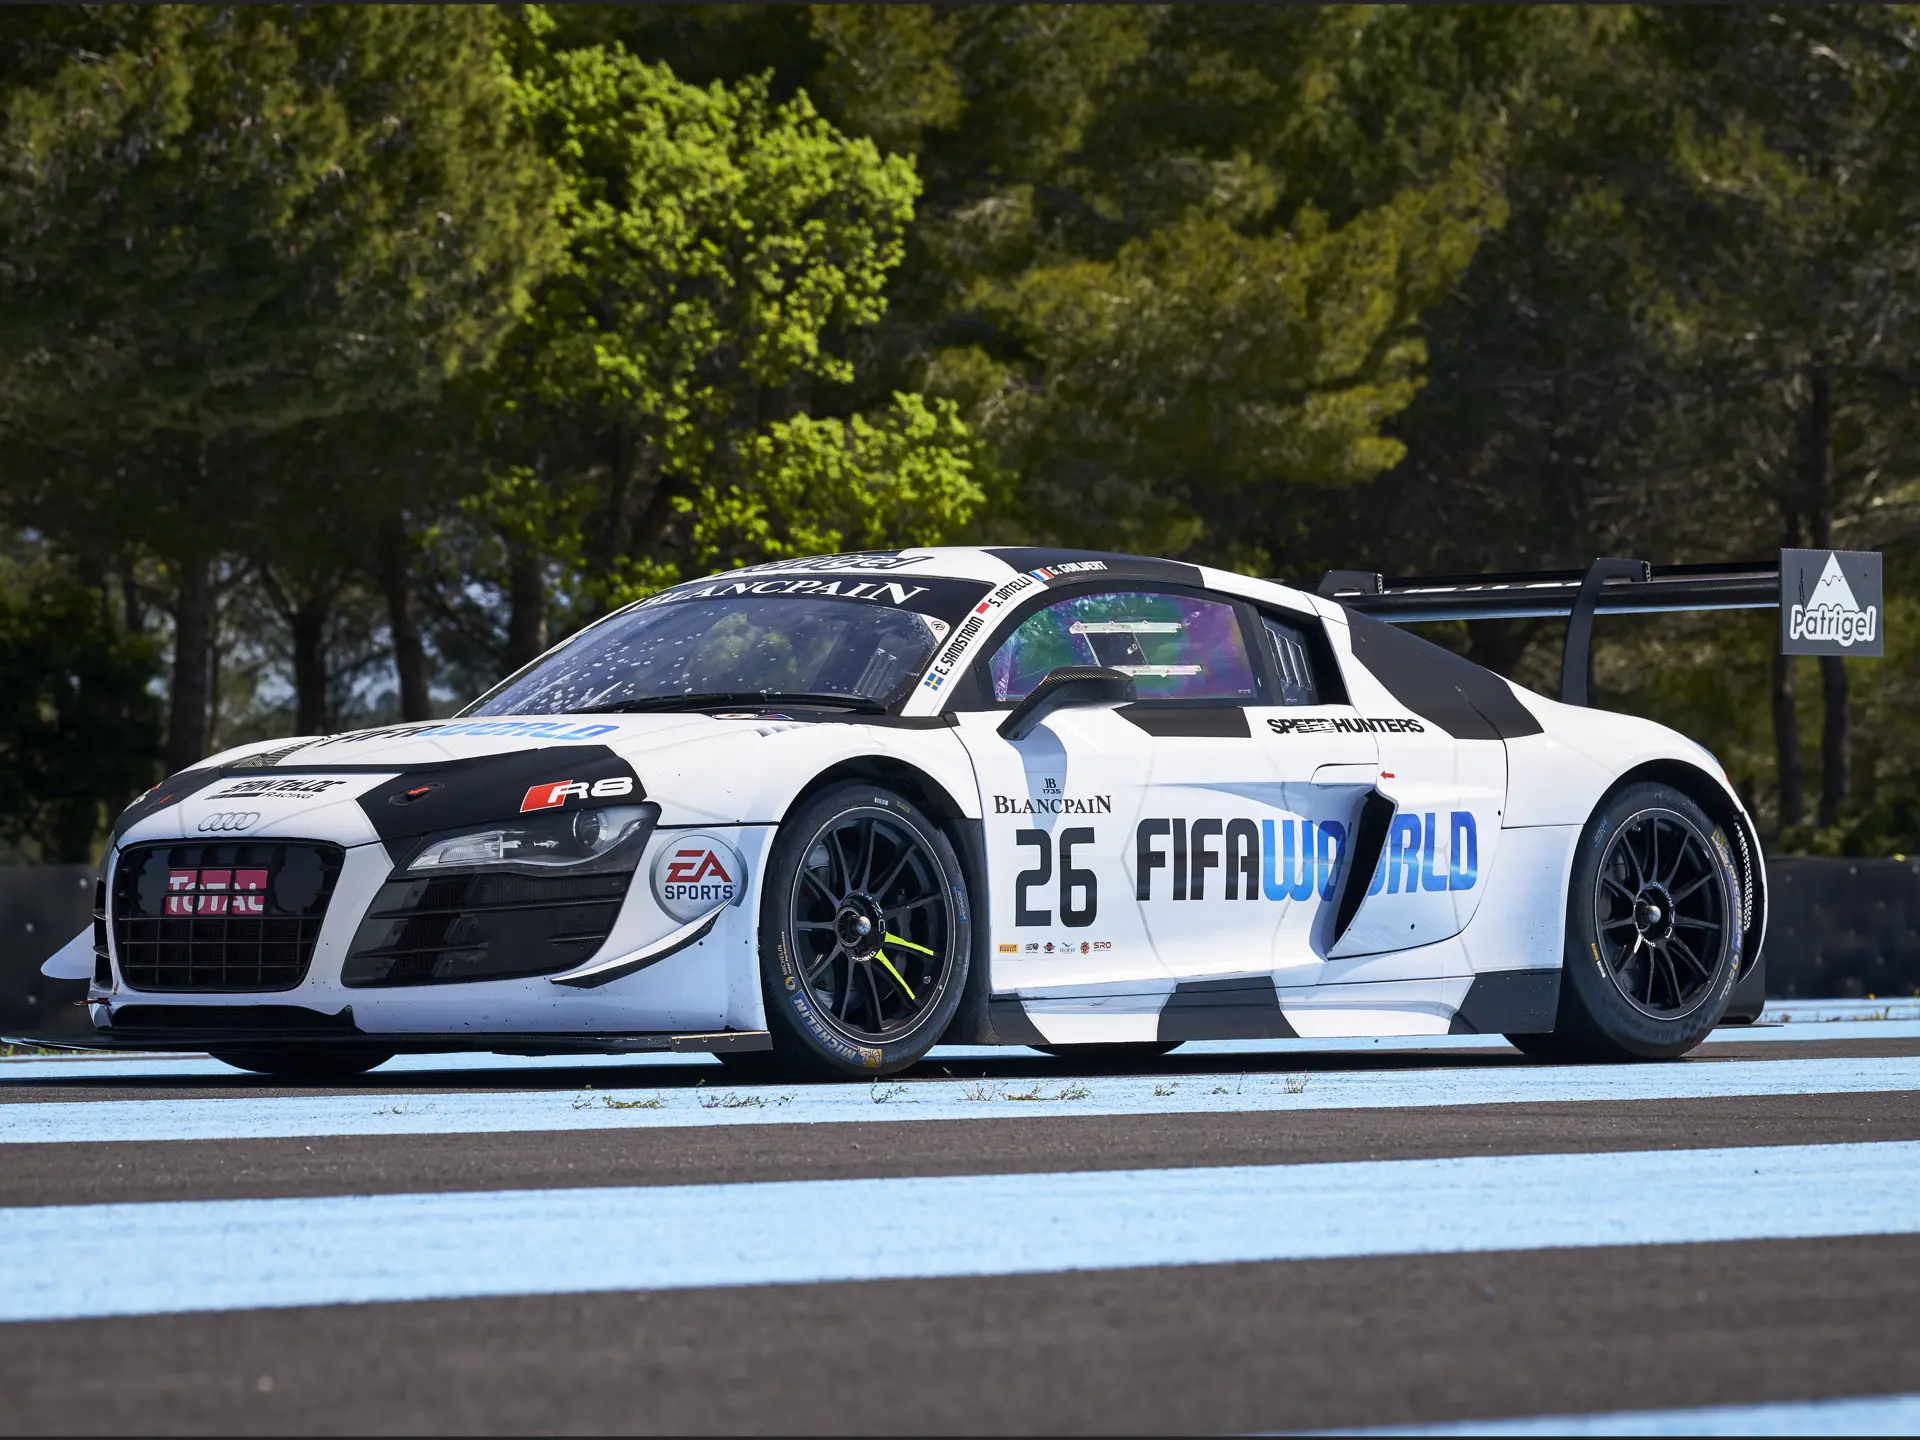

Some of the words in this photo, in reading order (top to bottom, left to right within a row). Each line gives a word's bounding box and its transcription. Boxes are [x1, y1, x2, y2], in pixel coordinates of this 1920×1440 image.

[1057, 560, 1108, 573] GUILVERT
[999, 576, 1034, 601] ORTELLI
[1792, 607, 1875, 643] Patrigel
[934, 664, 950, 676] E.
[1266, 718, 1425, 734] SPEEDHUNTERS
[547, 776, 634, 804] R8
[993, 795, 1112, 814] BLANCPAIN
[665, 850, 733, 883] EA
[1015, 827, 1098, 928] 26
[169, 876, 264, 913] TOTAL
[664, 884, 733, 900] SPORTS
[1093, 941, 1112, 949] SRO
[794, 998, 857, 1060] MICHELIN
